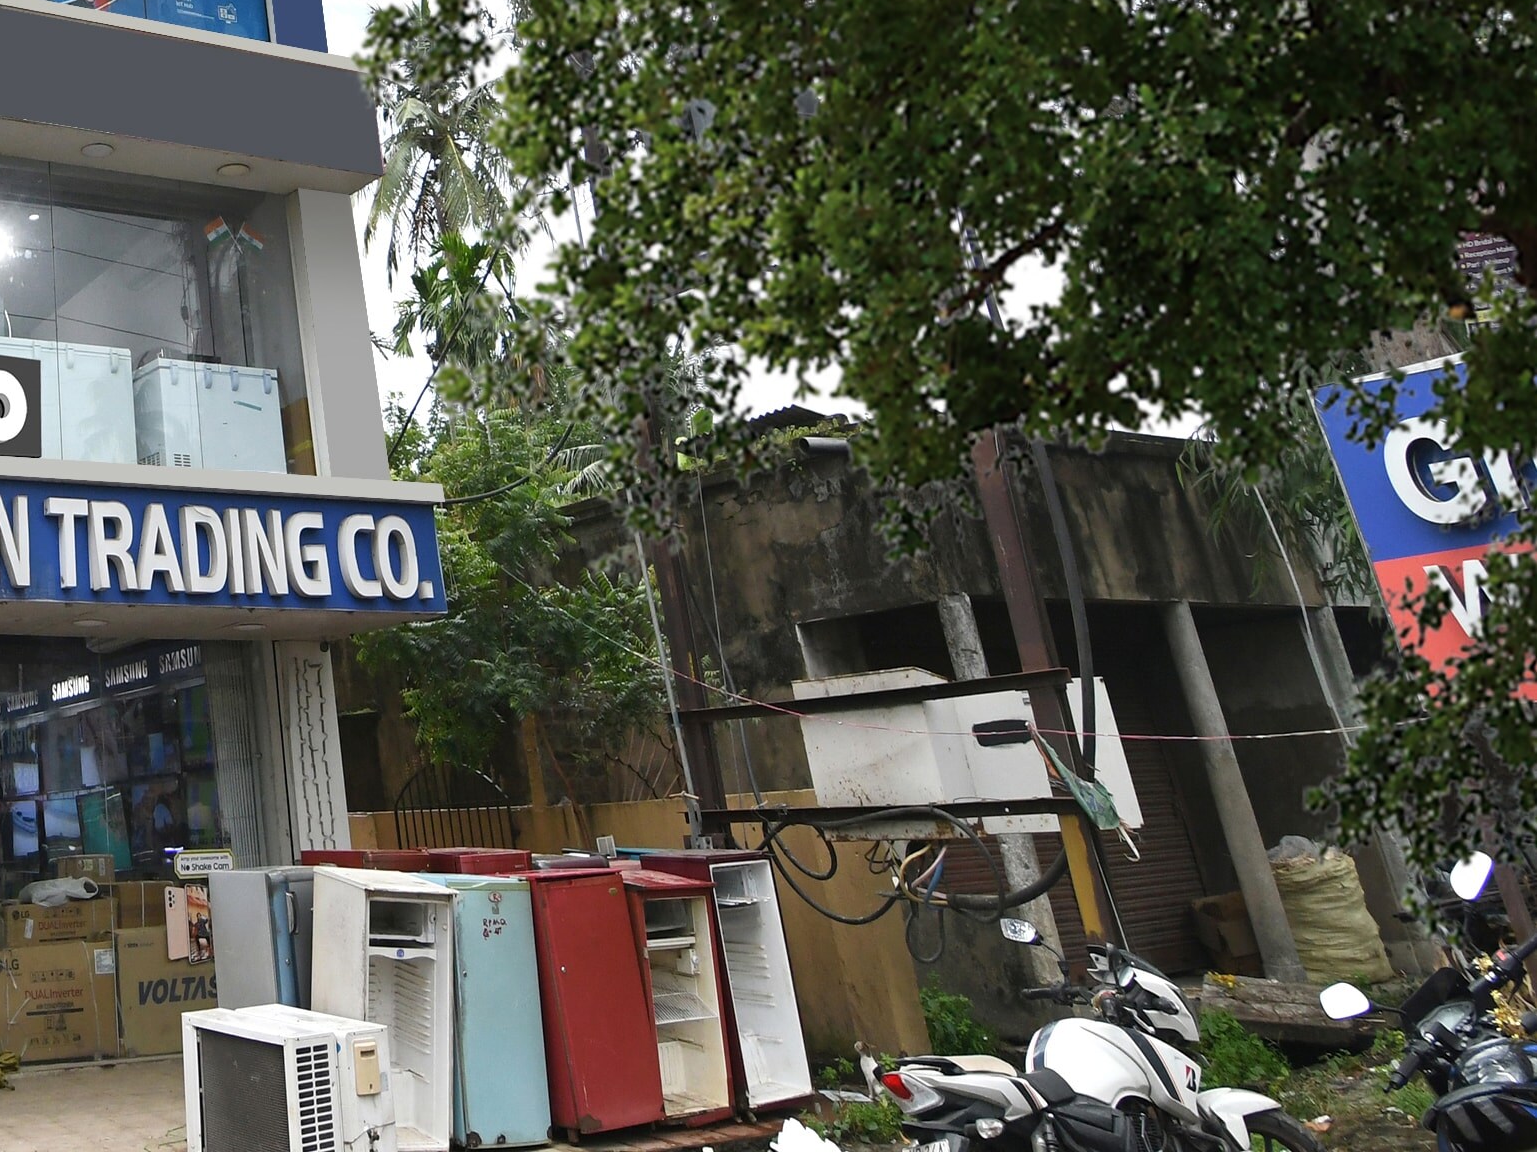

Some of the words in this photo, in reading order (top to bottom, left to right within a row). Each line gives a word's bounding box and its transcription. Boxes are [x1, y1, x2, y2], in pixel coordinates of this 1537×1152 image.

[1464, 248, 1496, 258] Reception
[43, 496, 332, 598] TRADING
[337, 513, 434, 601] CO.
[7, 689, 39, 713] SAMSUNG
[51, 674, 91, 702] SAMSUNG
[104, 659, 149, 688] SAMSUNG
[180, 863, 191, 872] No
[191, 863, 212, 871] Shake
[212, 862, 230, 870] Cam
[138, 974, 218, 1006] VOLTAS
